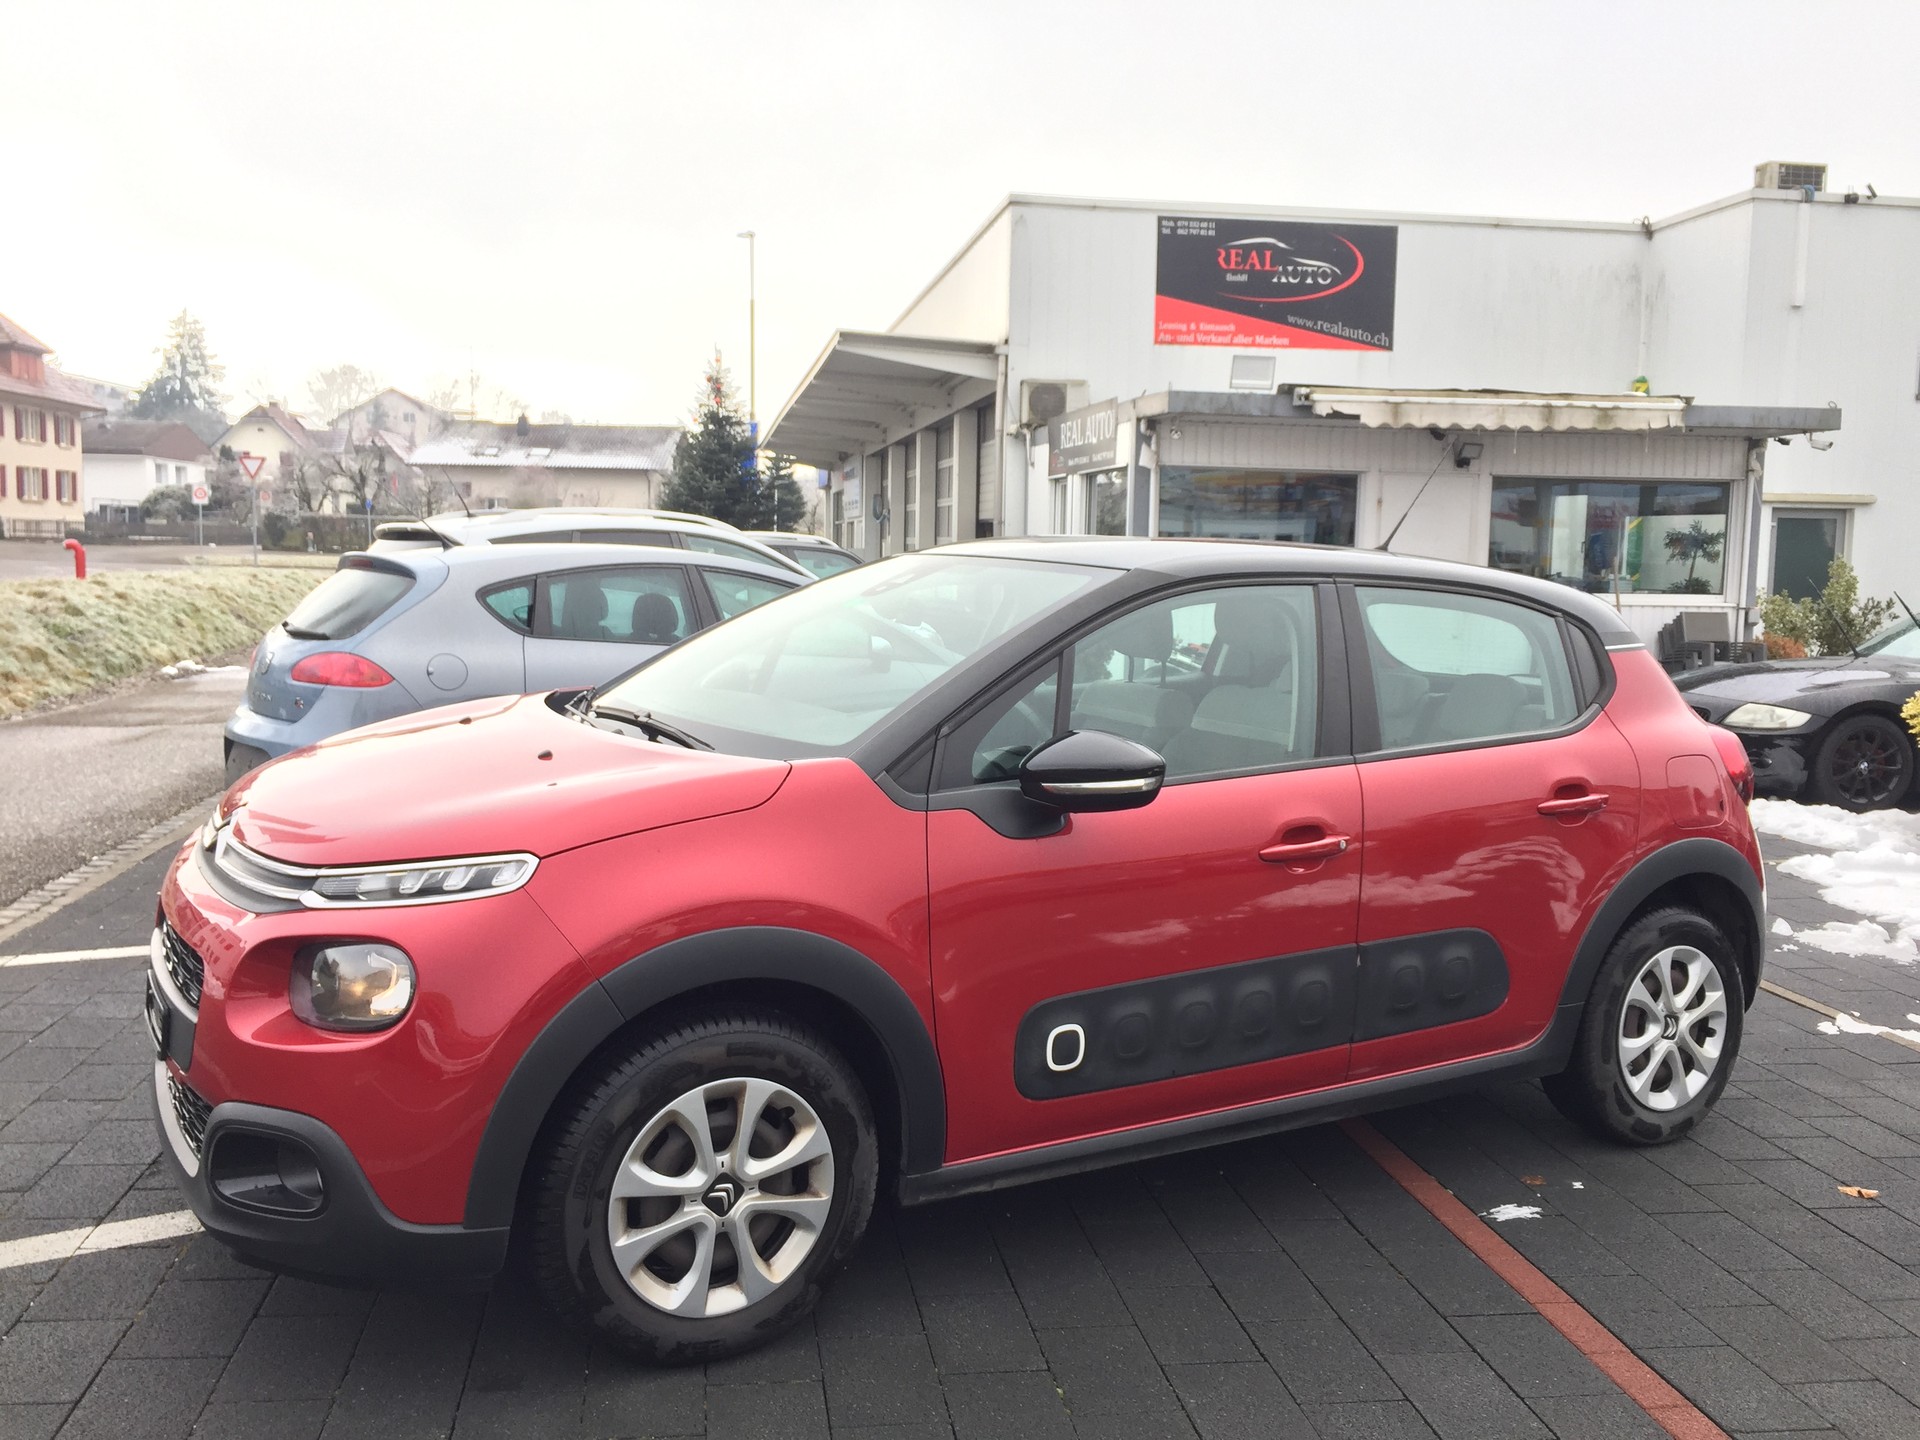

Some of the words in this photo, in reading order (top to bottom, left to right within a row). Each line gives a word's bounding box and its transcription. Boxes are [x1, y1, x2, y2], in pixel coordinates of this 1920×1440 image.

[1217, 248, 1279, 271] REAL
[1271, 265, 1333, 285] AUTO
[1177, 332, 1195, 343] und
[1196, 332, 1232, 344] Verkauf
[1232, 334, 1254, 345] aller
[1254, 335, 1290, 346] Marken
[1286, 314, 1390, 347] www.realauto.ch
[1060, 418, 1084, 449] REAL
